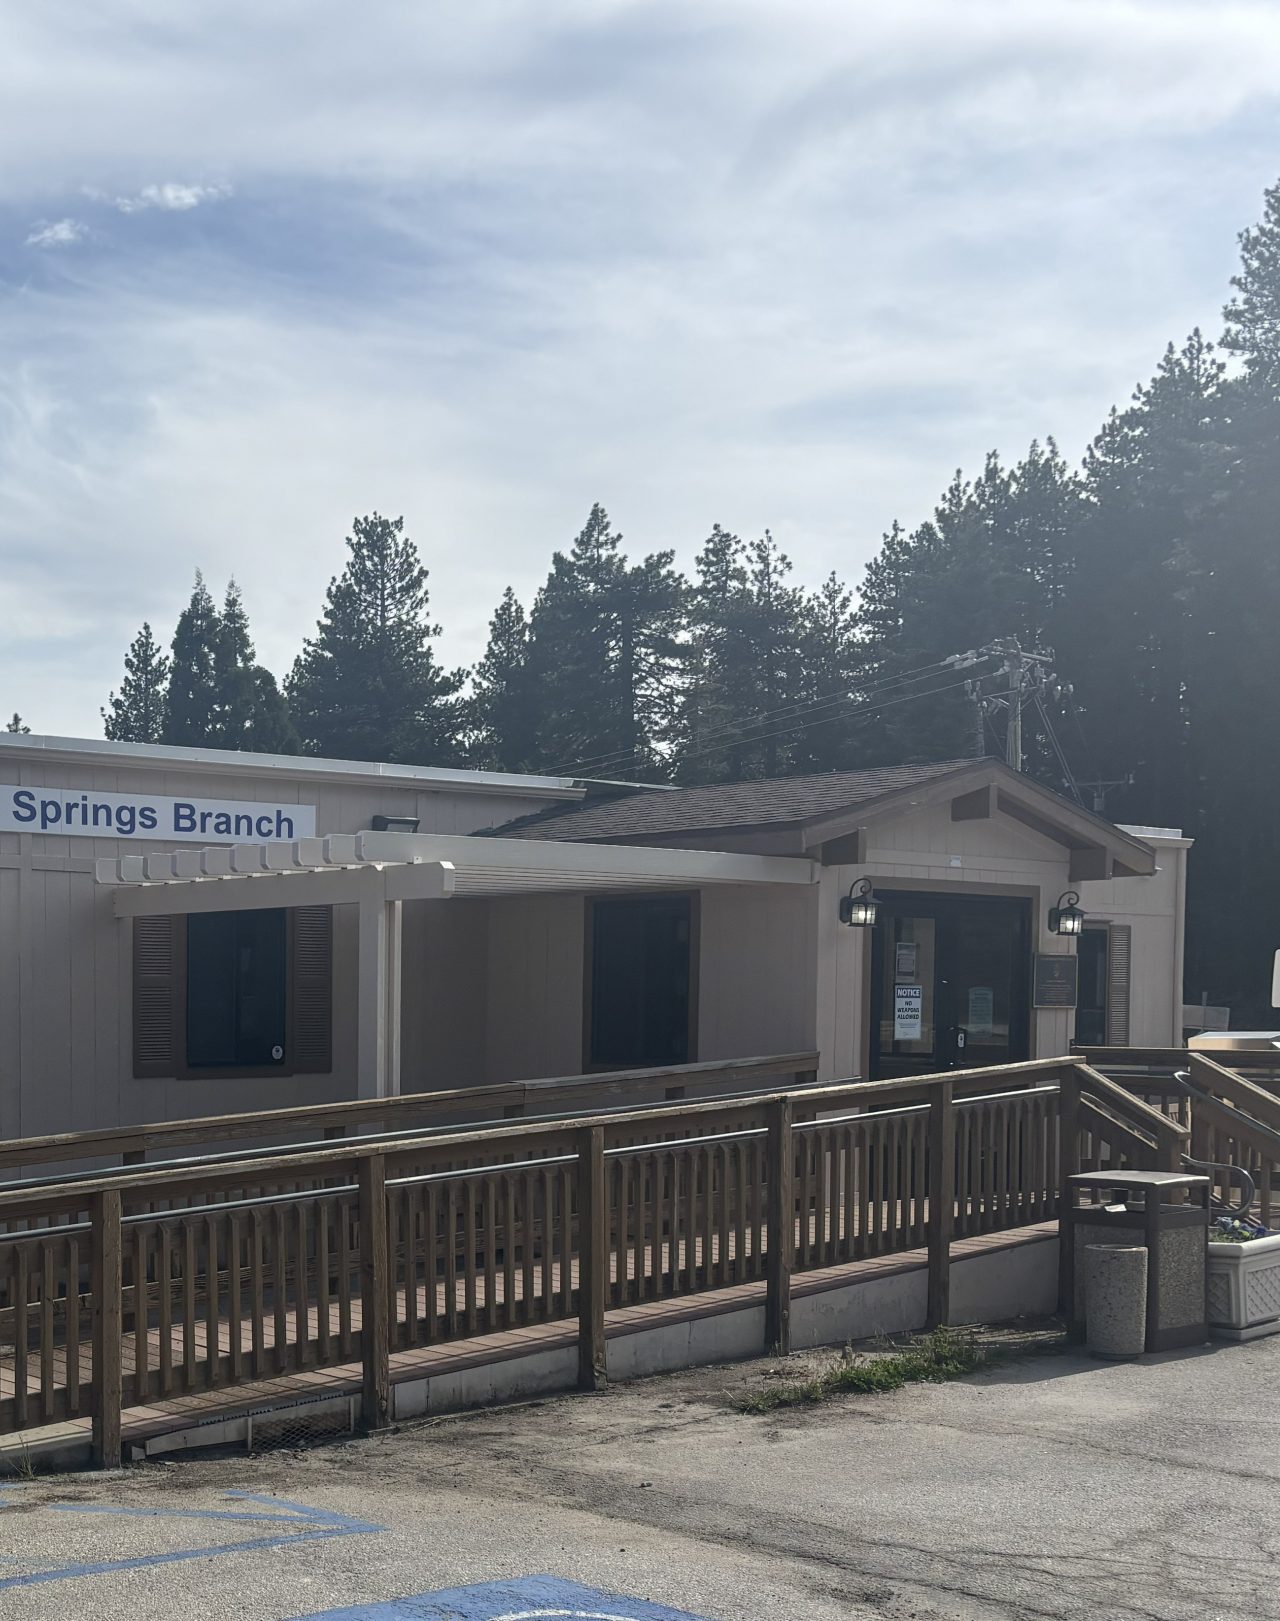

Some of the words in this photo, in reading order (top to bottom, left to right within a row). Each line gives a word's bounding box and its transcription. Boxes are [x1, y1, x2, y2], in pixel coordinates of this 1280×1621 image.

[12, 790, 158, 834] Springs
[174, 803, 294, 838] Branch
[898, 989, 920, 997] NOTICE
